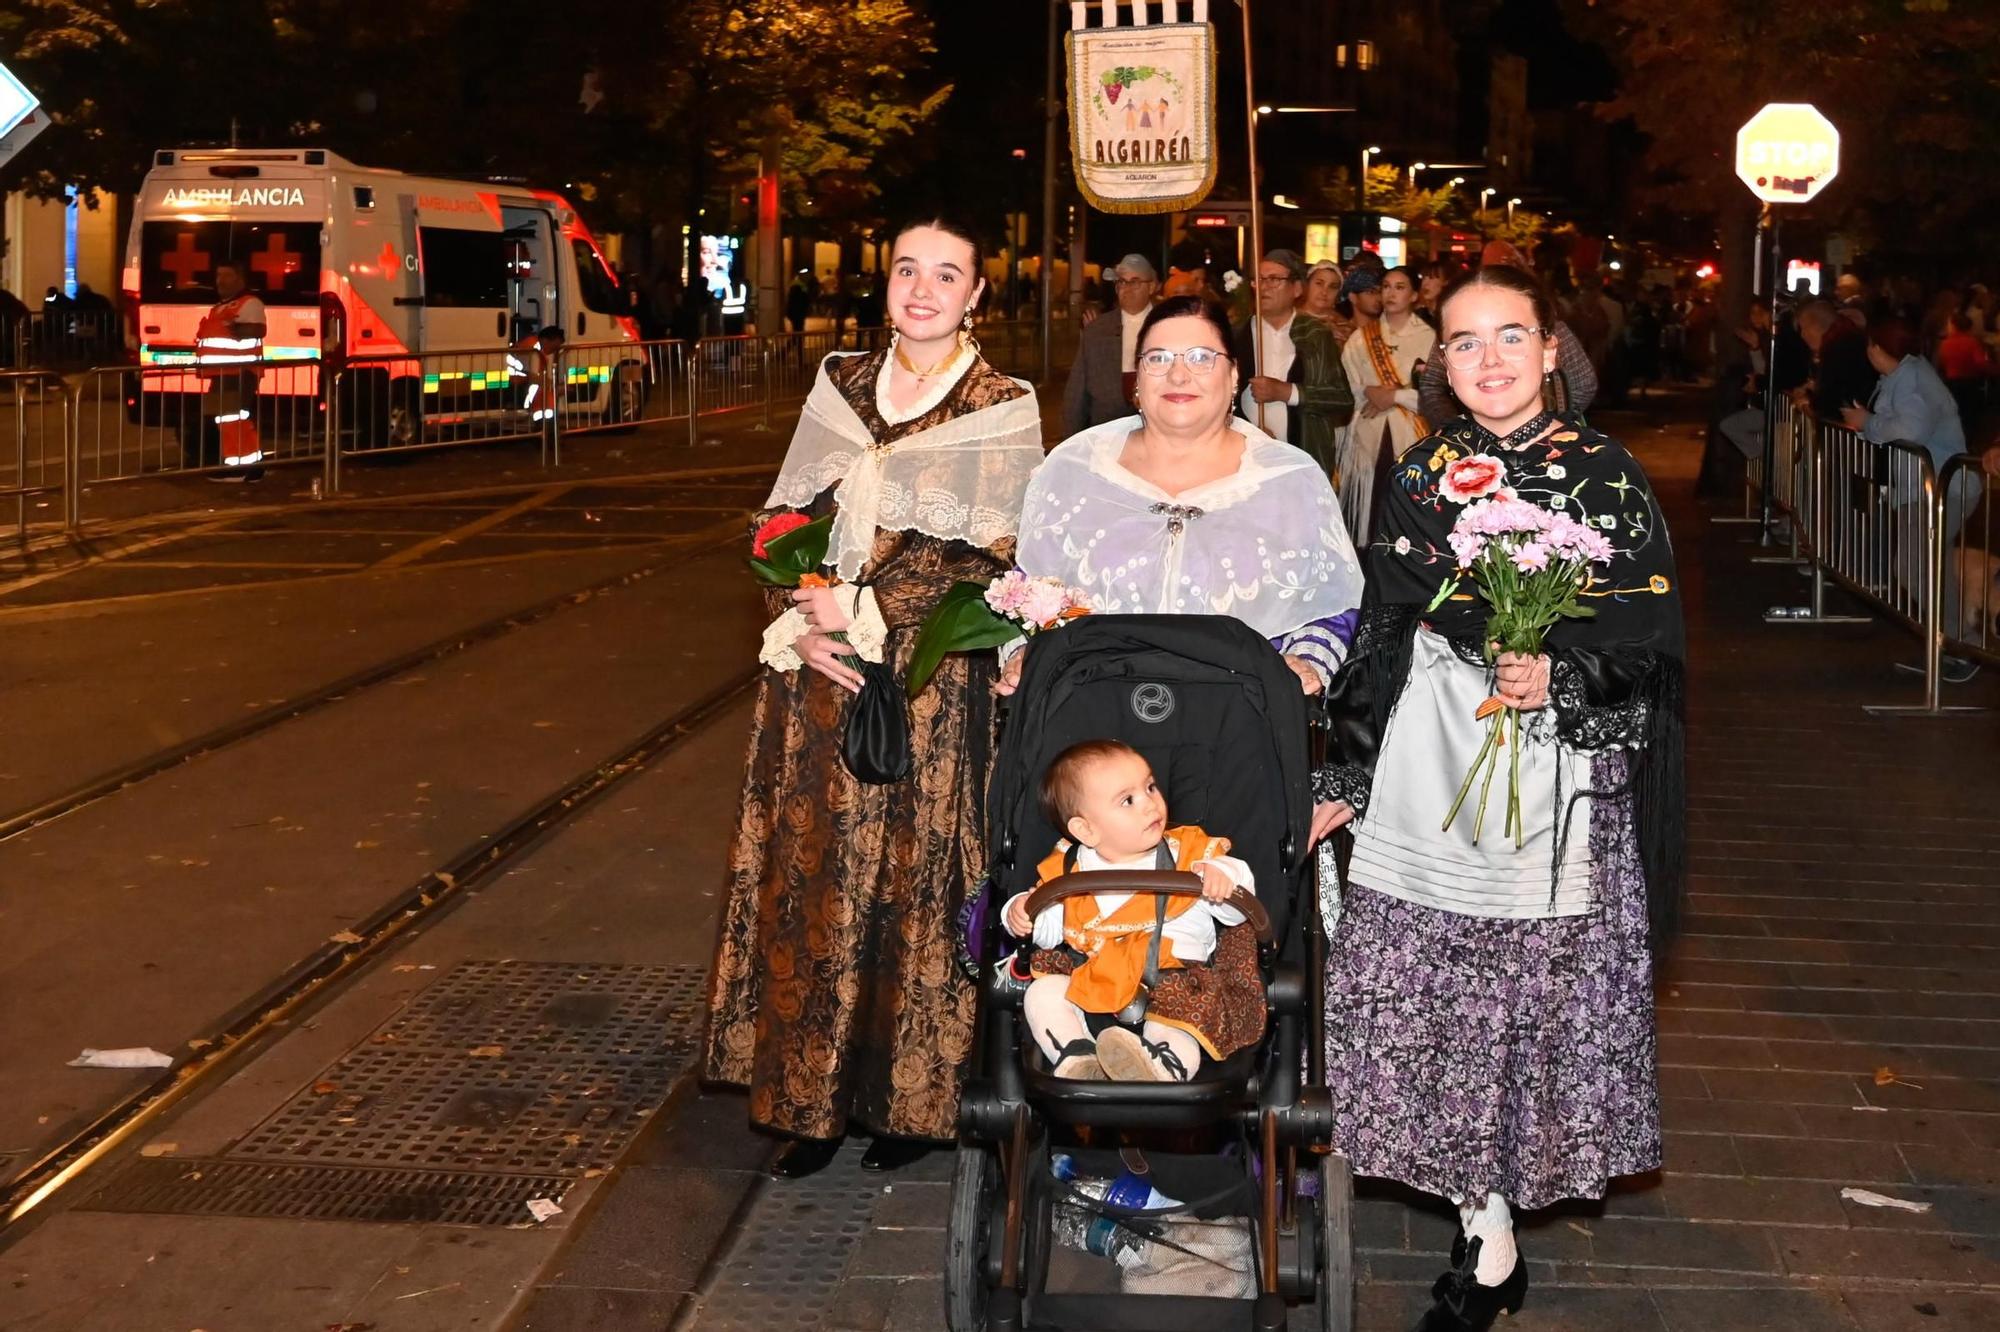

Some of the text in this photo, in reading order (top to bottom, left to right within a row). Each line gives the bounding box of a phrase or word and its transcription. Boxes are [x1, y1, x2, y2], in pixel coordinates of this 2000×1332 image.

[1095, 130, 1190, 163] ALGAIRÉN
[1748, 142, 1828, 166] STOP
[161, 188, 304, 206] AMBULANCIA
